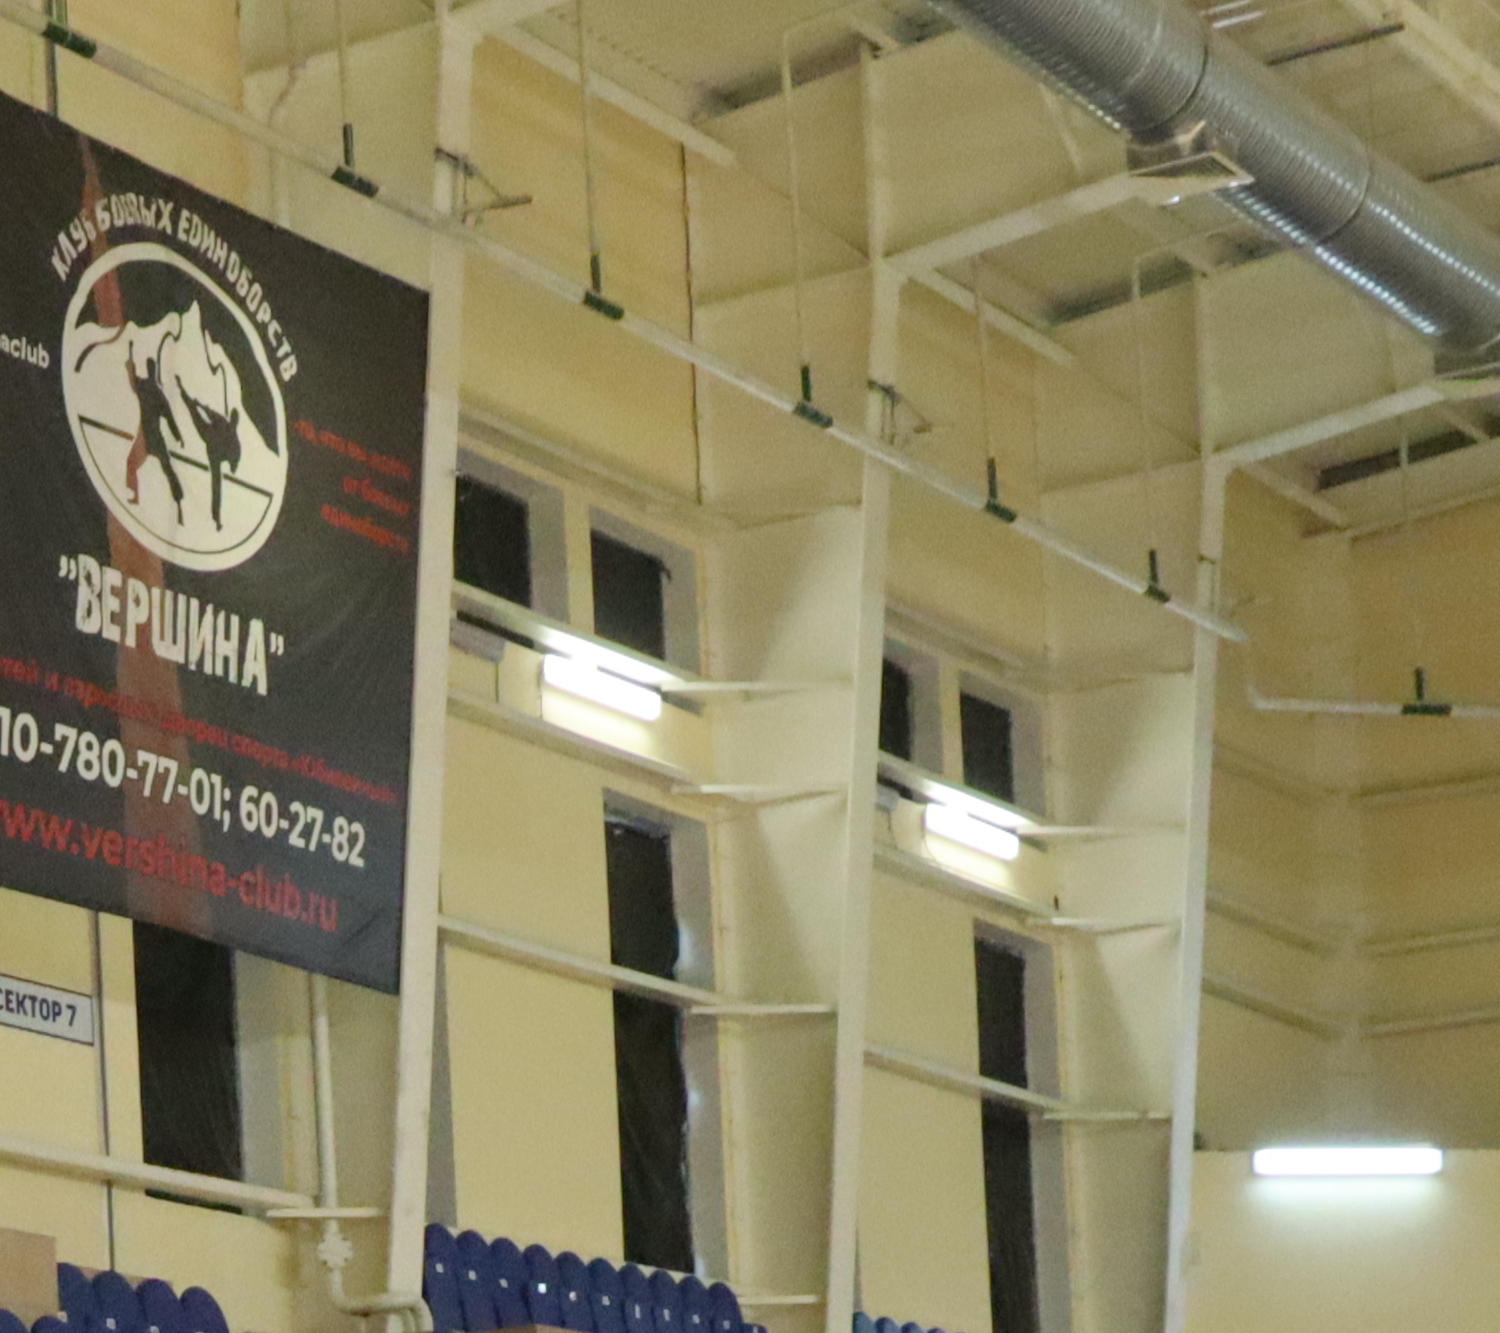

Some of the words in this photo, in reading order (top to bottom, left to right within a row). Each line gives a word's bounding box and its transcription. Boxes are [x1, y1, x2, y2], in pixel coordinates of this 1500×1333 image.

[177, 208, 299, 383] ЕДИНОБОРСТВ
[239, 785, 367, 869] 60-27-82
[66, 1005, 77, 1028] 7
